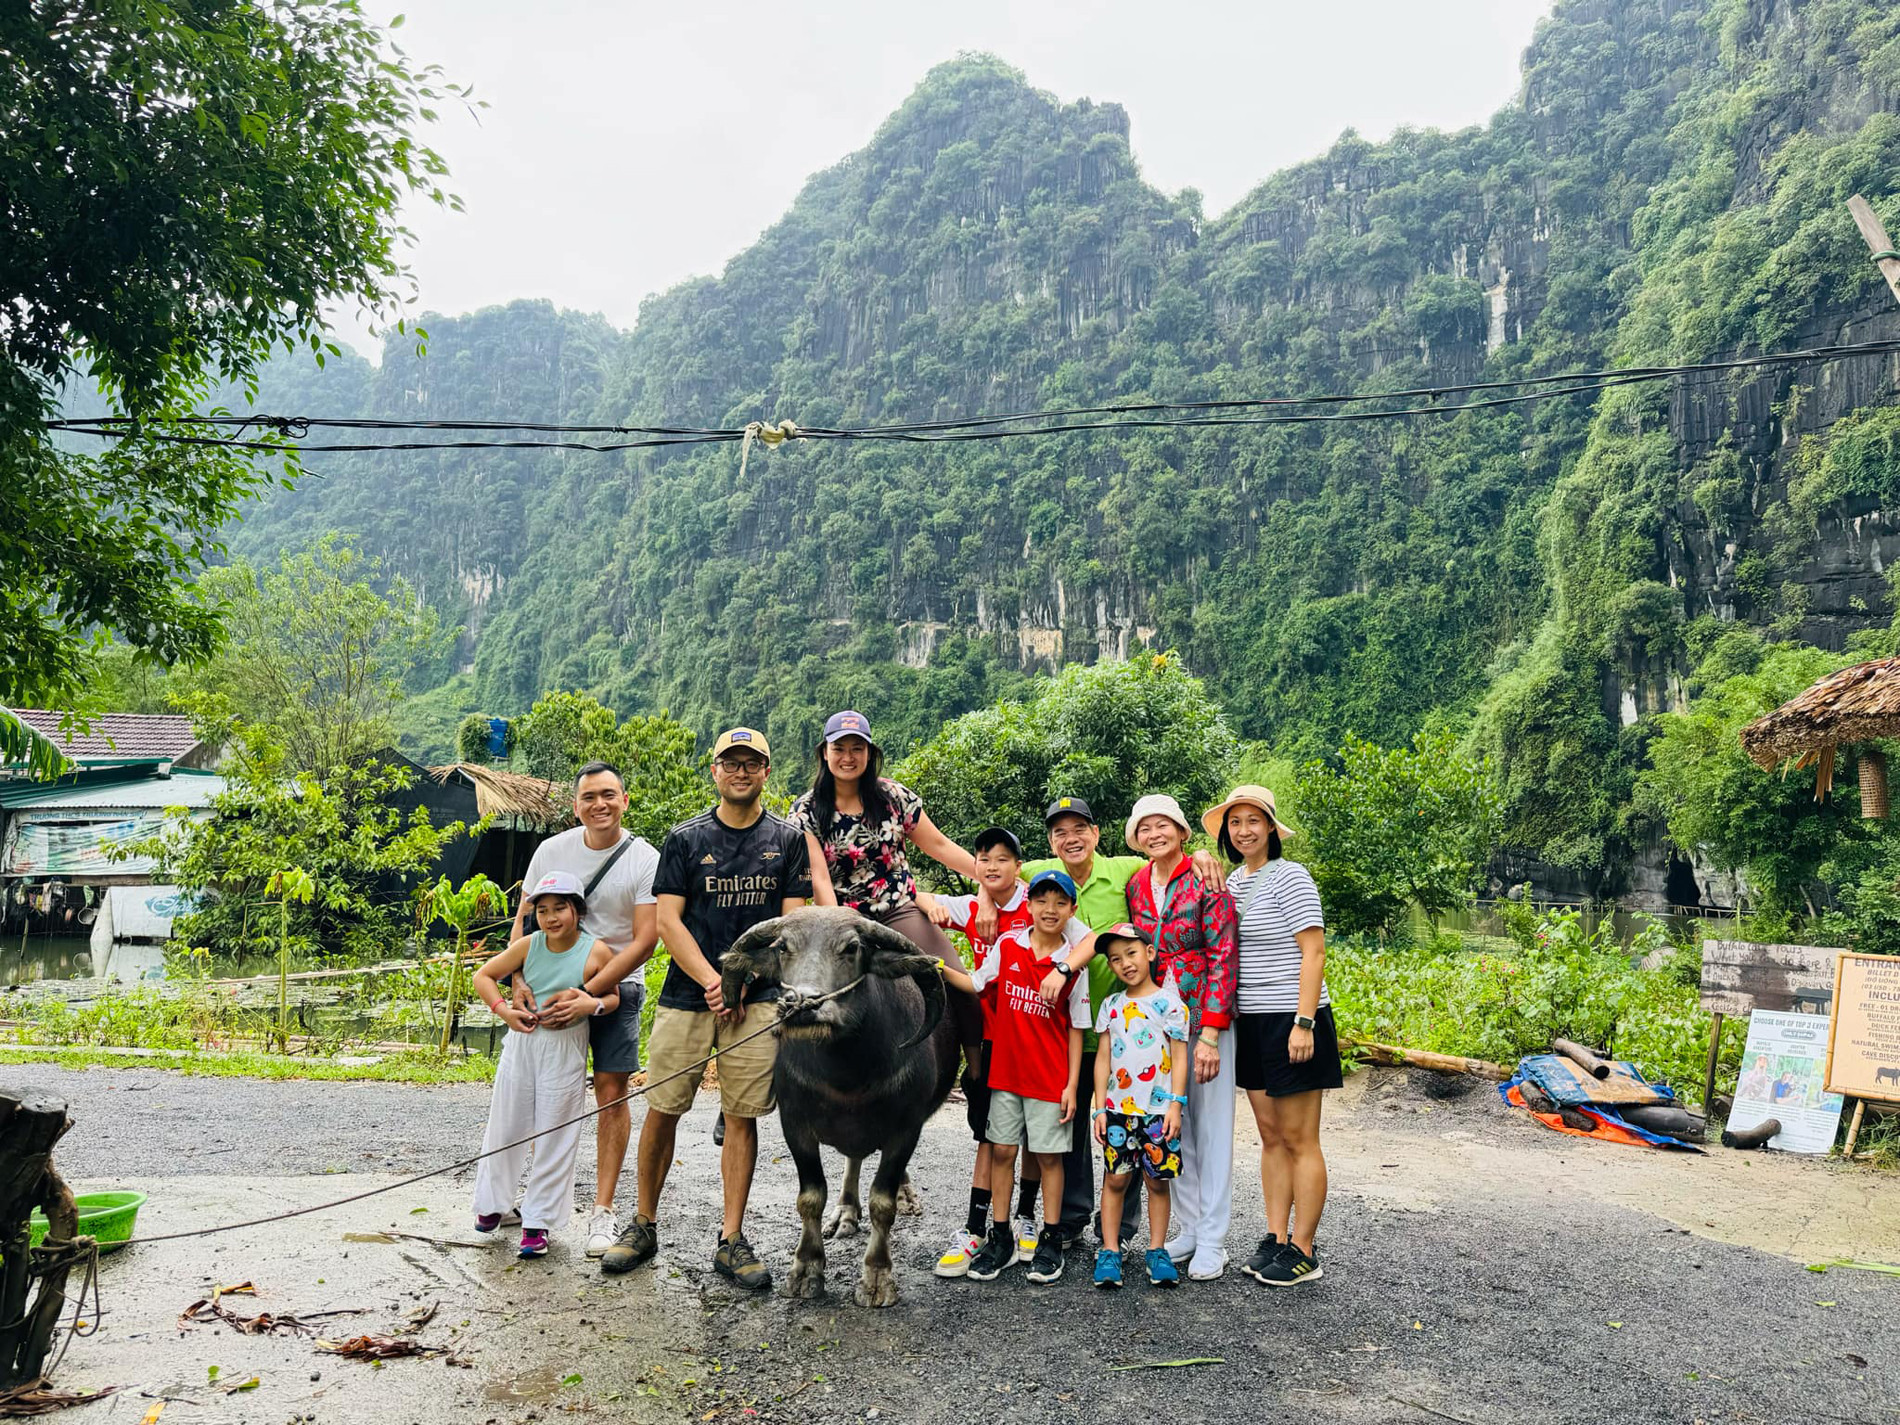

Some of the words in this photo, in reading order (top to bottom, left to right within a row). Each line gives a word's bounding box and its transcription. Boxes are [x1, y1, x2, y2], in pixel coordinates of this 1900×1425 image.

[705, 875, 777, 892] Emirates
[717, 893, 733, 908] FLY
[1005, 980, 1055, 1009] Emira
[1009, 998, 1021, 1010] FLY
[1753, 1017, 1774, 1025] CHOOSE
